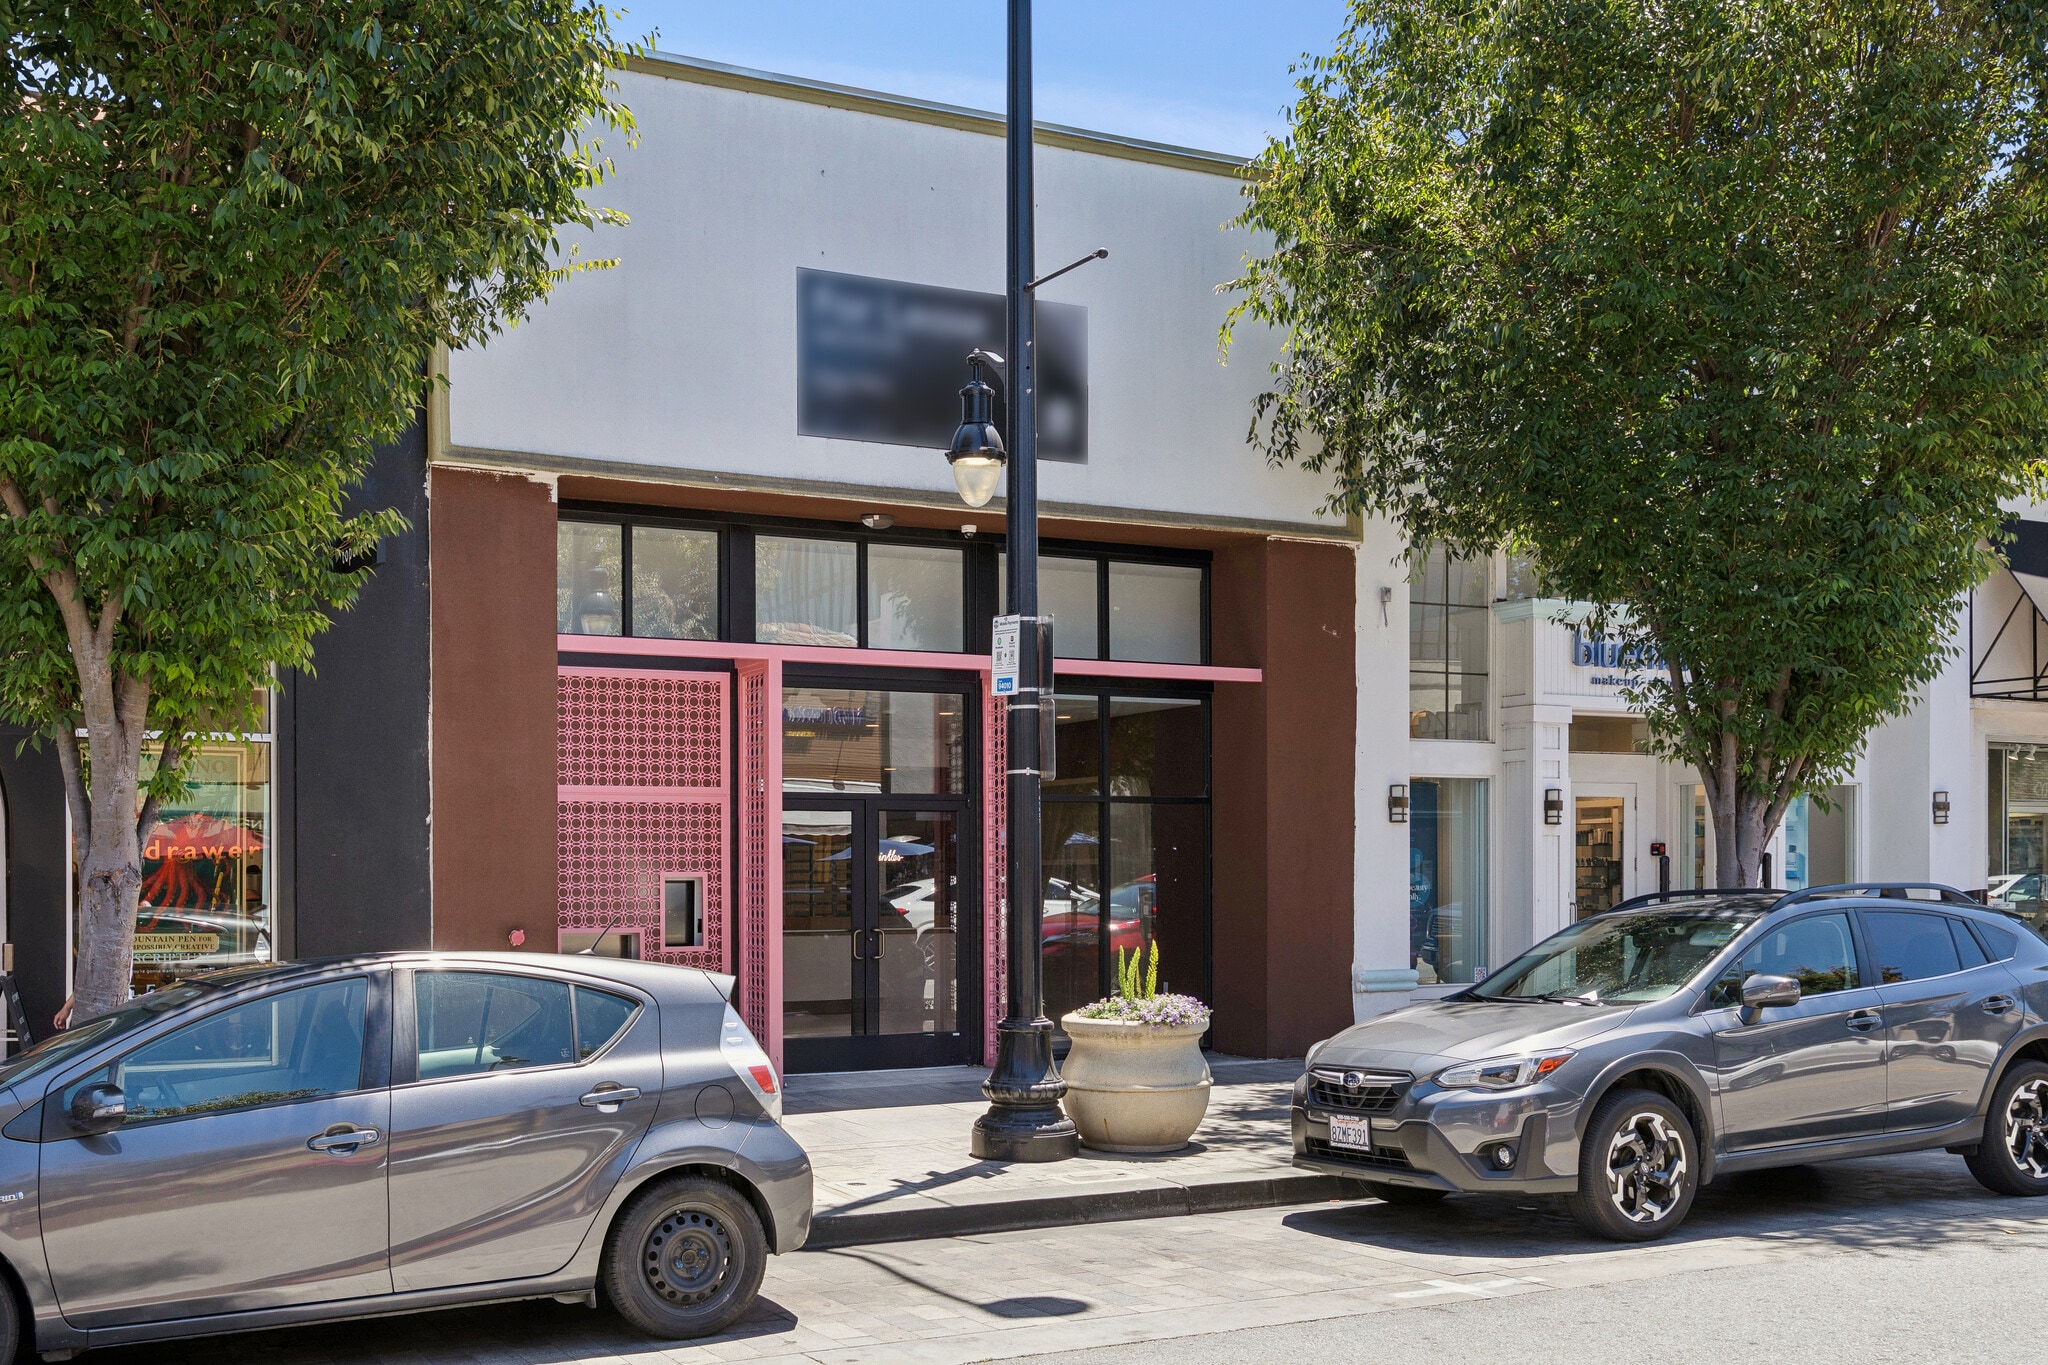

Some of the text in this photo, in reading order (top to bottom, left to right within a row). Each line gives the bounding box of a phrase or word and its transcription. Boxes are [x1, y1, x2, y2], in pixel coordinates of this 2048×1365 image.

[1591, 674, 1639, 690] makeup
[145, 839, 261, 861] drawer
[134, 935, 175, 943] OUNTAIN
[178, 935, 196, 943] PEN
[1332, 1126, 1367, 1145] 8ZMF391
